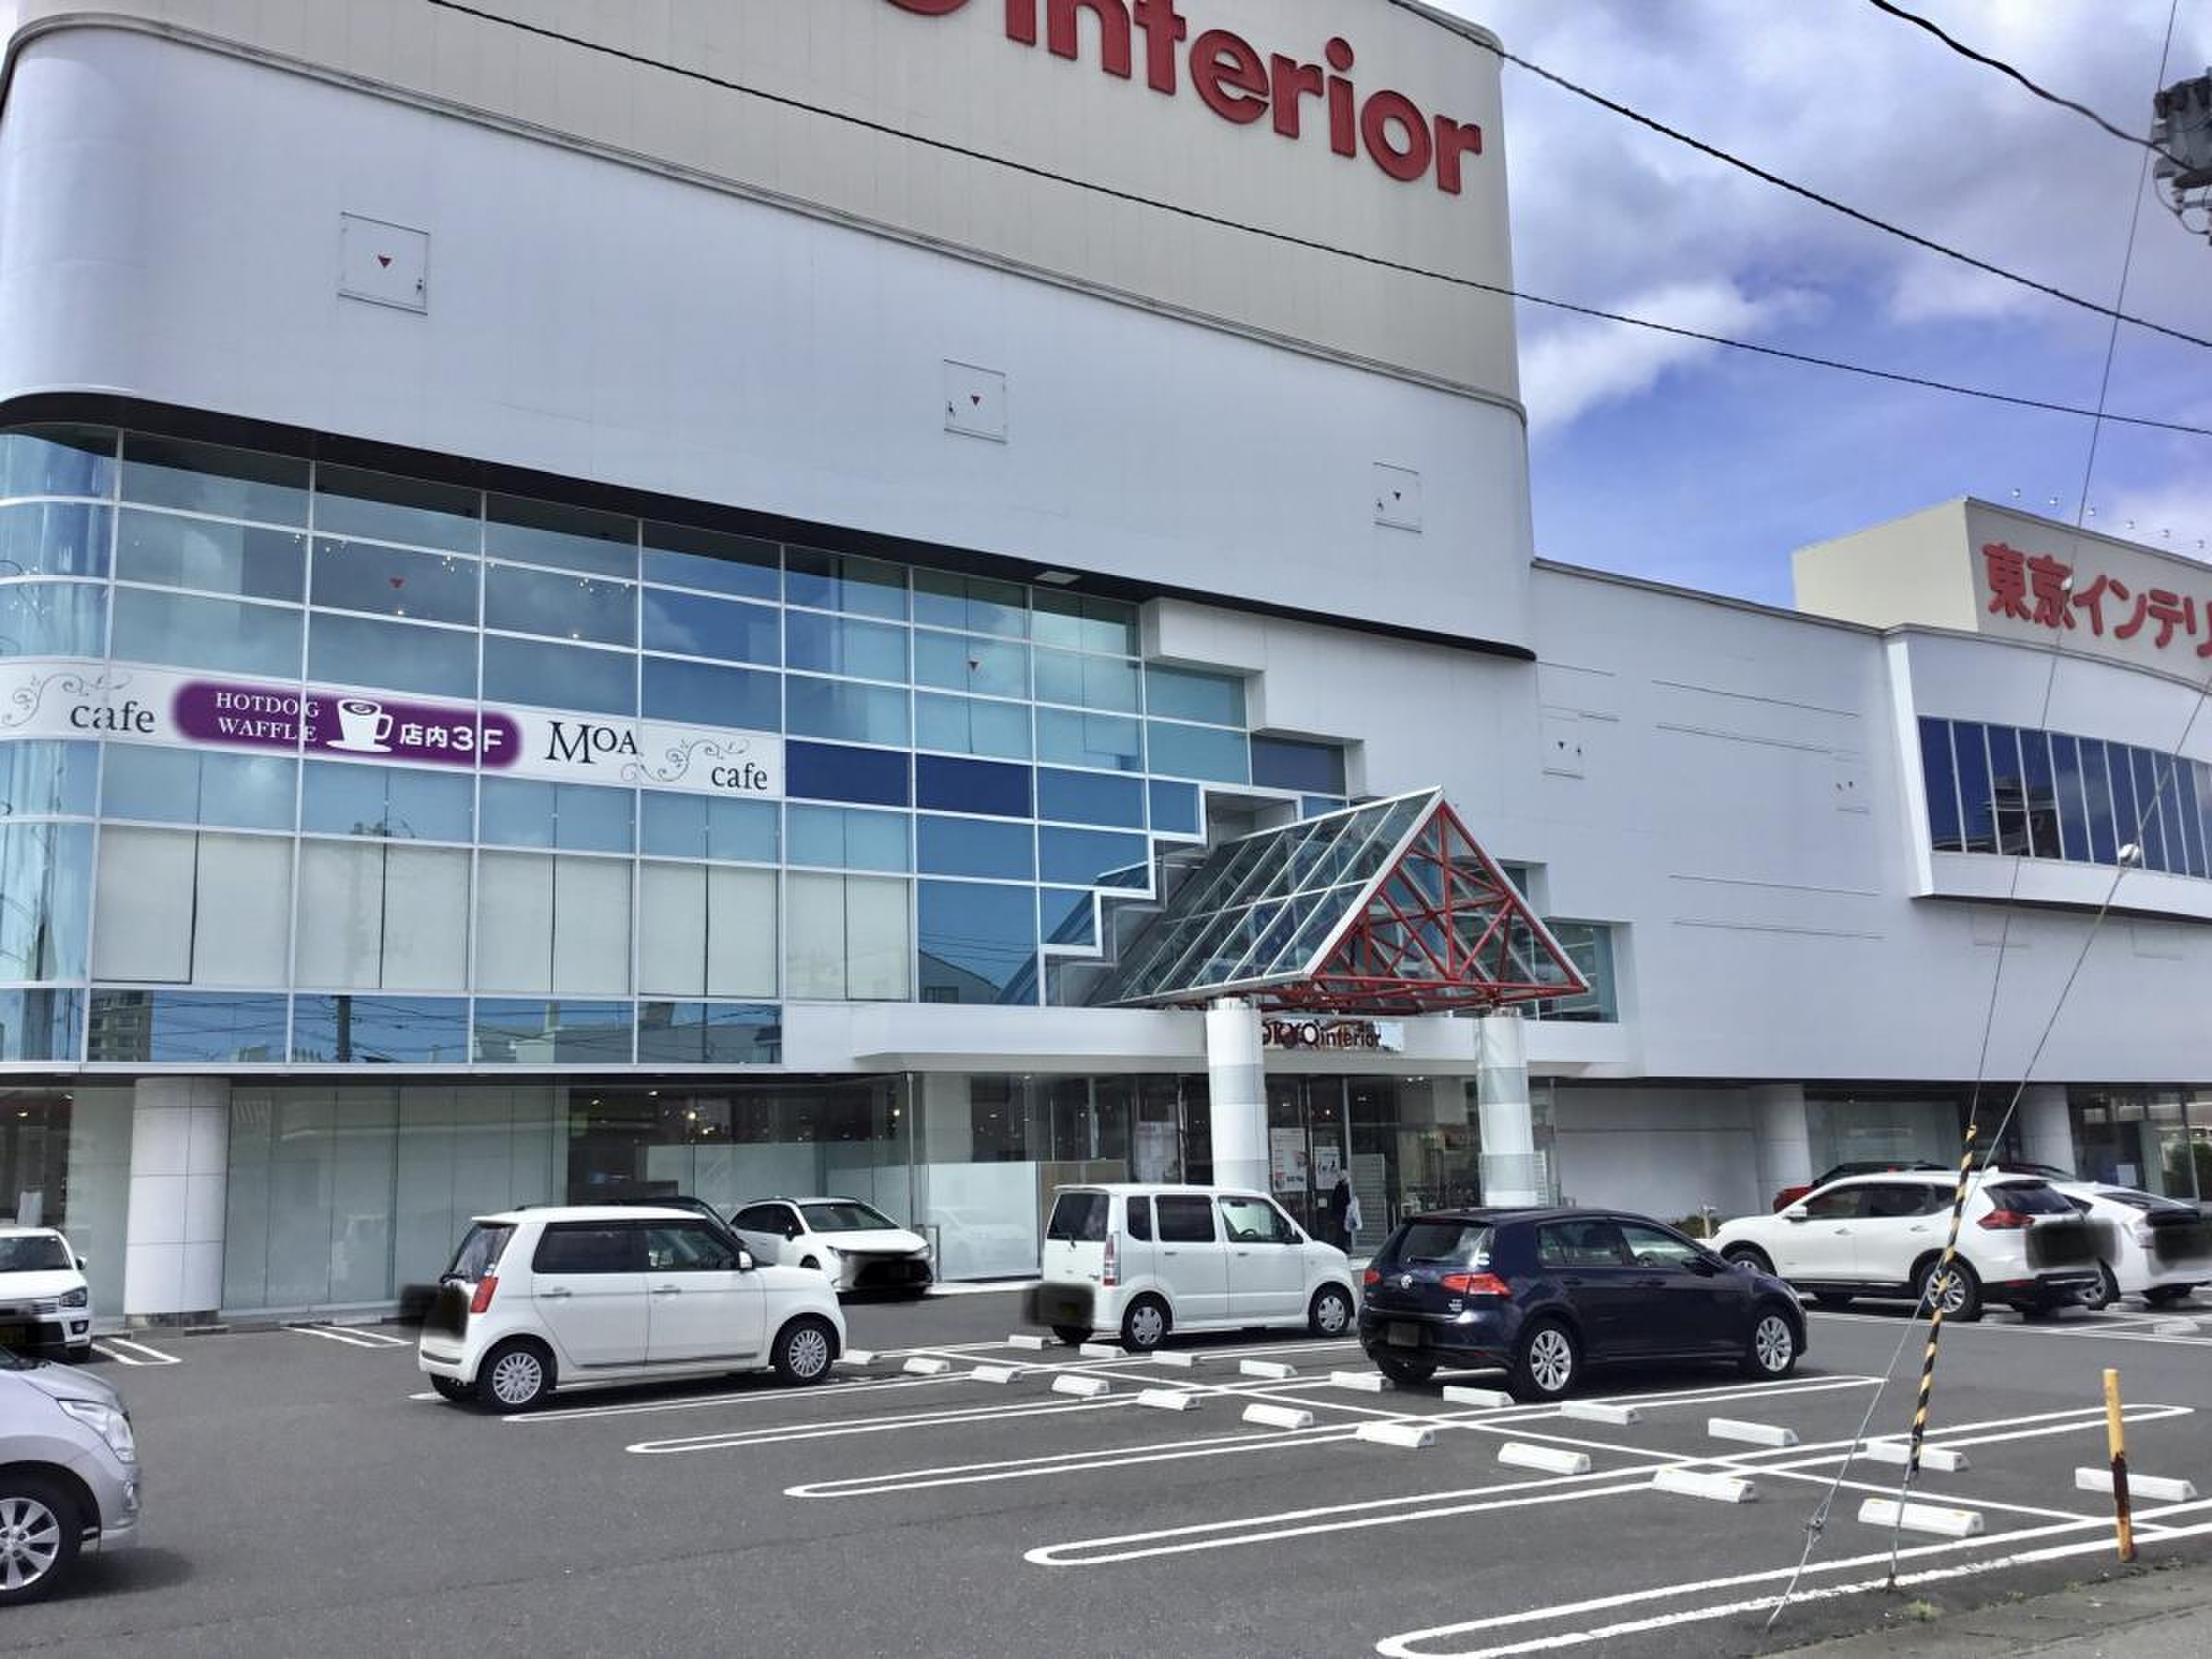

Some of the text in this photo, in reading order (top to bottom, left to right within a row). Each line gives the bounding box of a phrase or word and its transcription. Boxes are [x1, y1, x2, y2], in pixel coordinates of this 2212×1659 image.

[1983, 543, 2212, 658] 東京インテリ
[70, 700, 156, 734] cafe
[216, 691, 320, 719] HOTDOG
[218, 716, 318, 742] WAFFLE
[399, 722, 504, 753] 店内3F
[545, 721, 639, 764] MOA
[711, 761, 768, 791] cafe
